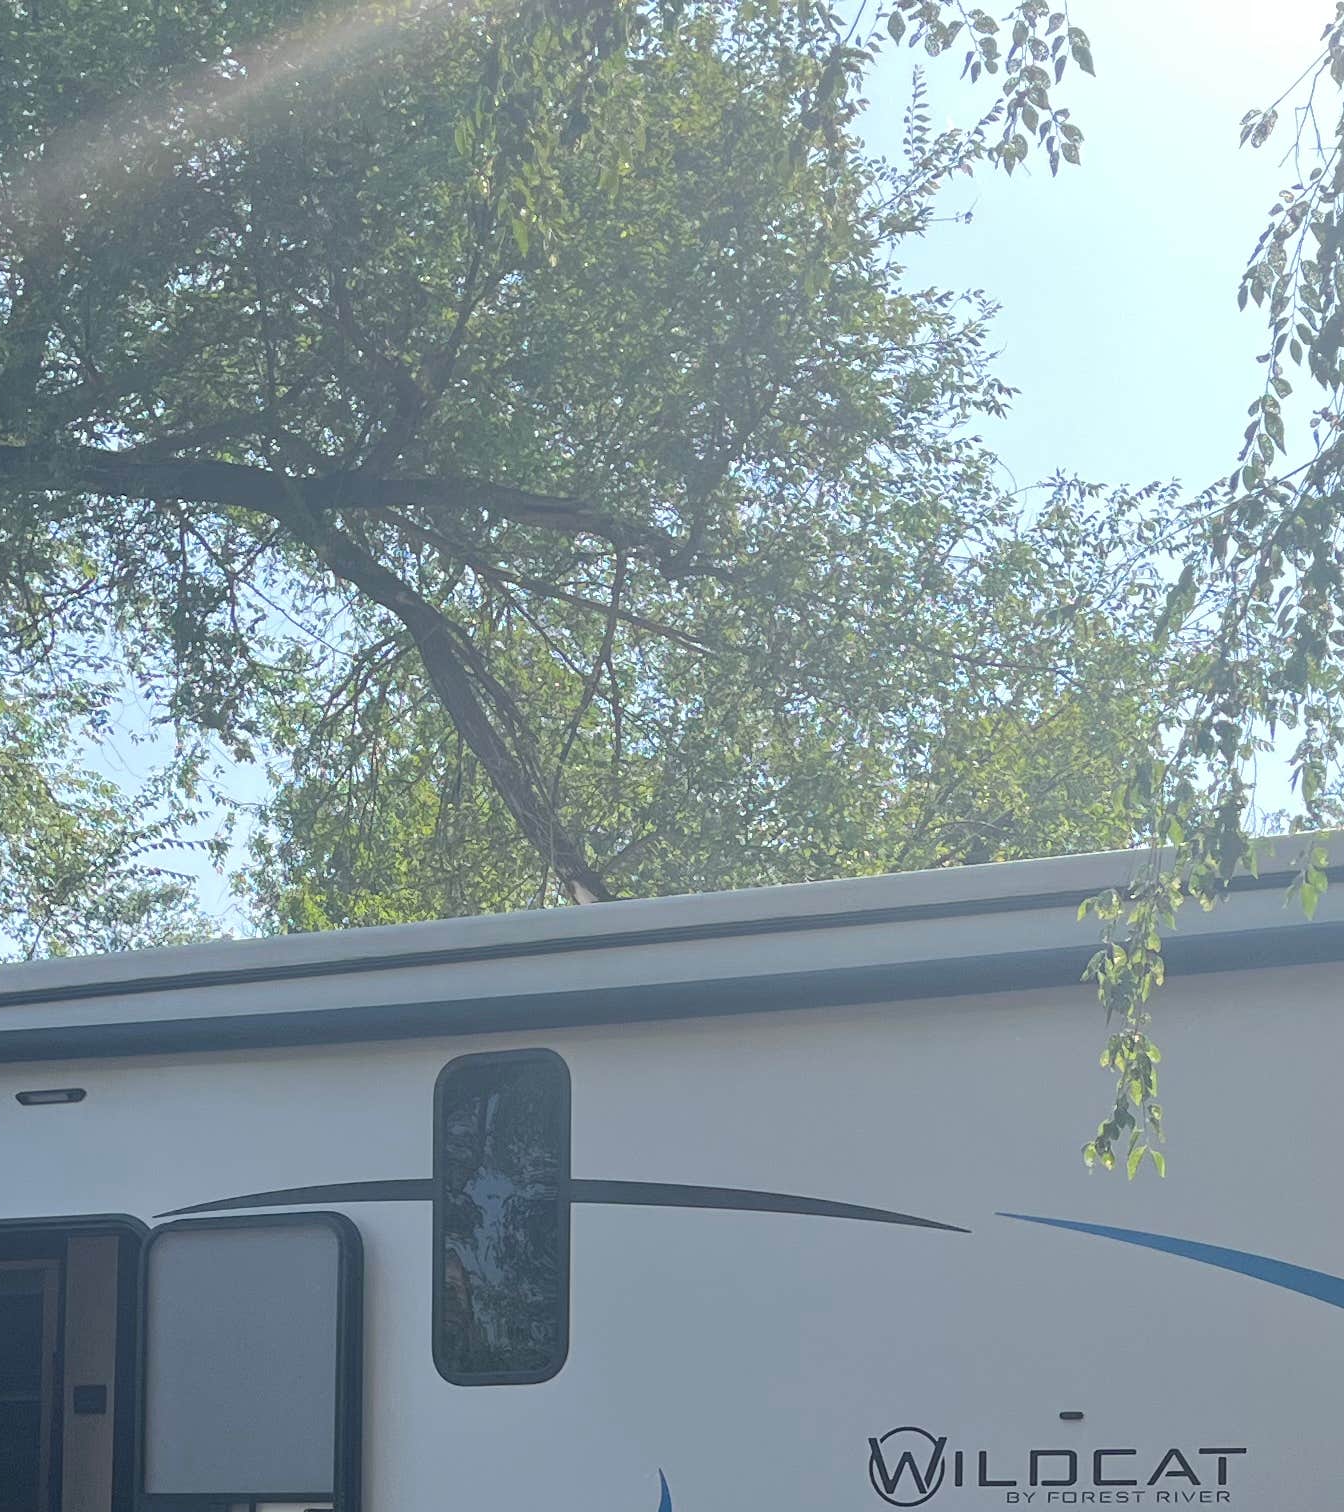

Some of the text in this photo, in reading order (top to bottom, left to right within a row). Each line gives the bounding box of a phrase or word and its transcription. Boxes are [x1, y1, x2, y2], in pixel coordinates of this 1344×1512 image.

[867, 1435, 1247, 1496] WILDCAT
[1006, 1491, 1231, 1505] BY FOREST RIVER
